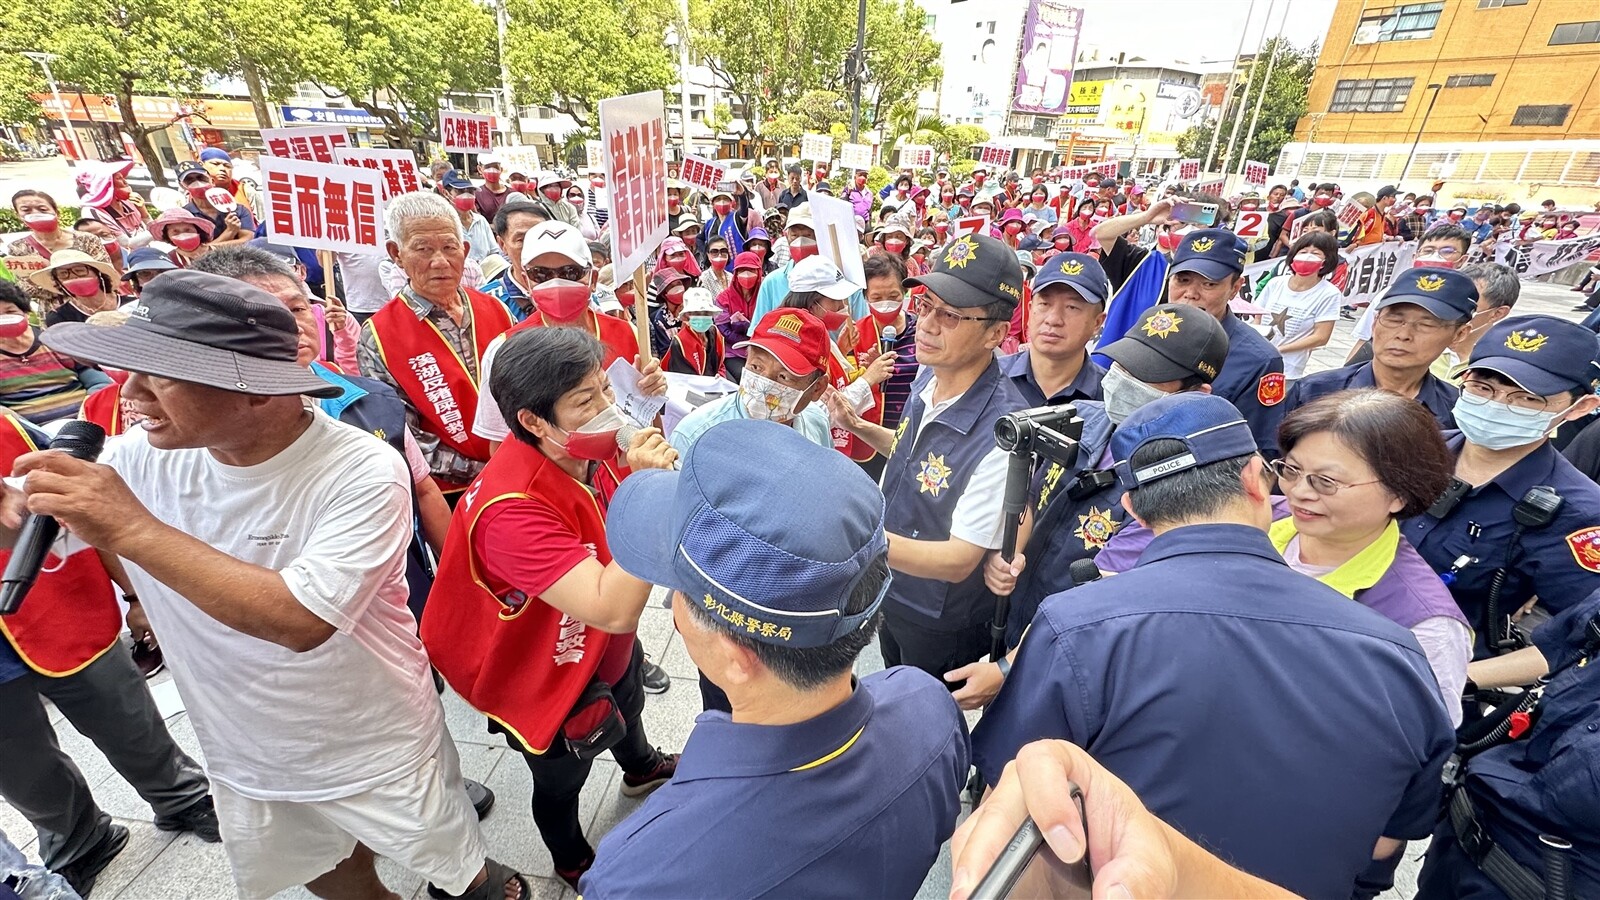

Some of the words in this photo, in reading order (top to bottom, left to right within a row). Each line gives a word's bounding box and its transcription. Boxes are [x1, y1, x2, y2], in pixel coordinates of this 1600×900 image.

[444, 117, 490, 149] 公然欺騙
[681, 158, 724, 191] 罔顧民意
[267, 171, 377, 247] 言而無信
[1237, 213, 1263, 237] 2
[959, 218, 985, 234] 7
[1152, 459, 1182, 475] POLICE
[702, 593, 792, 642] 彰化縣警察局
